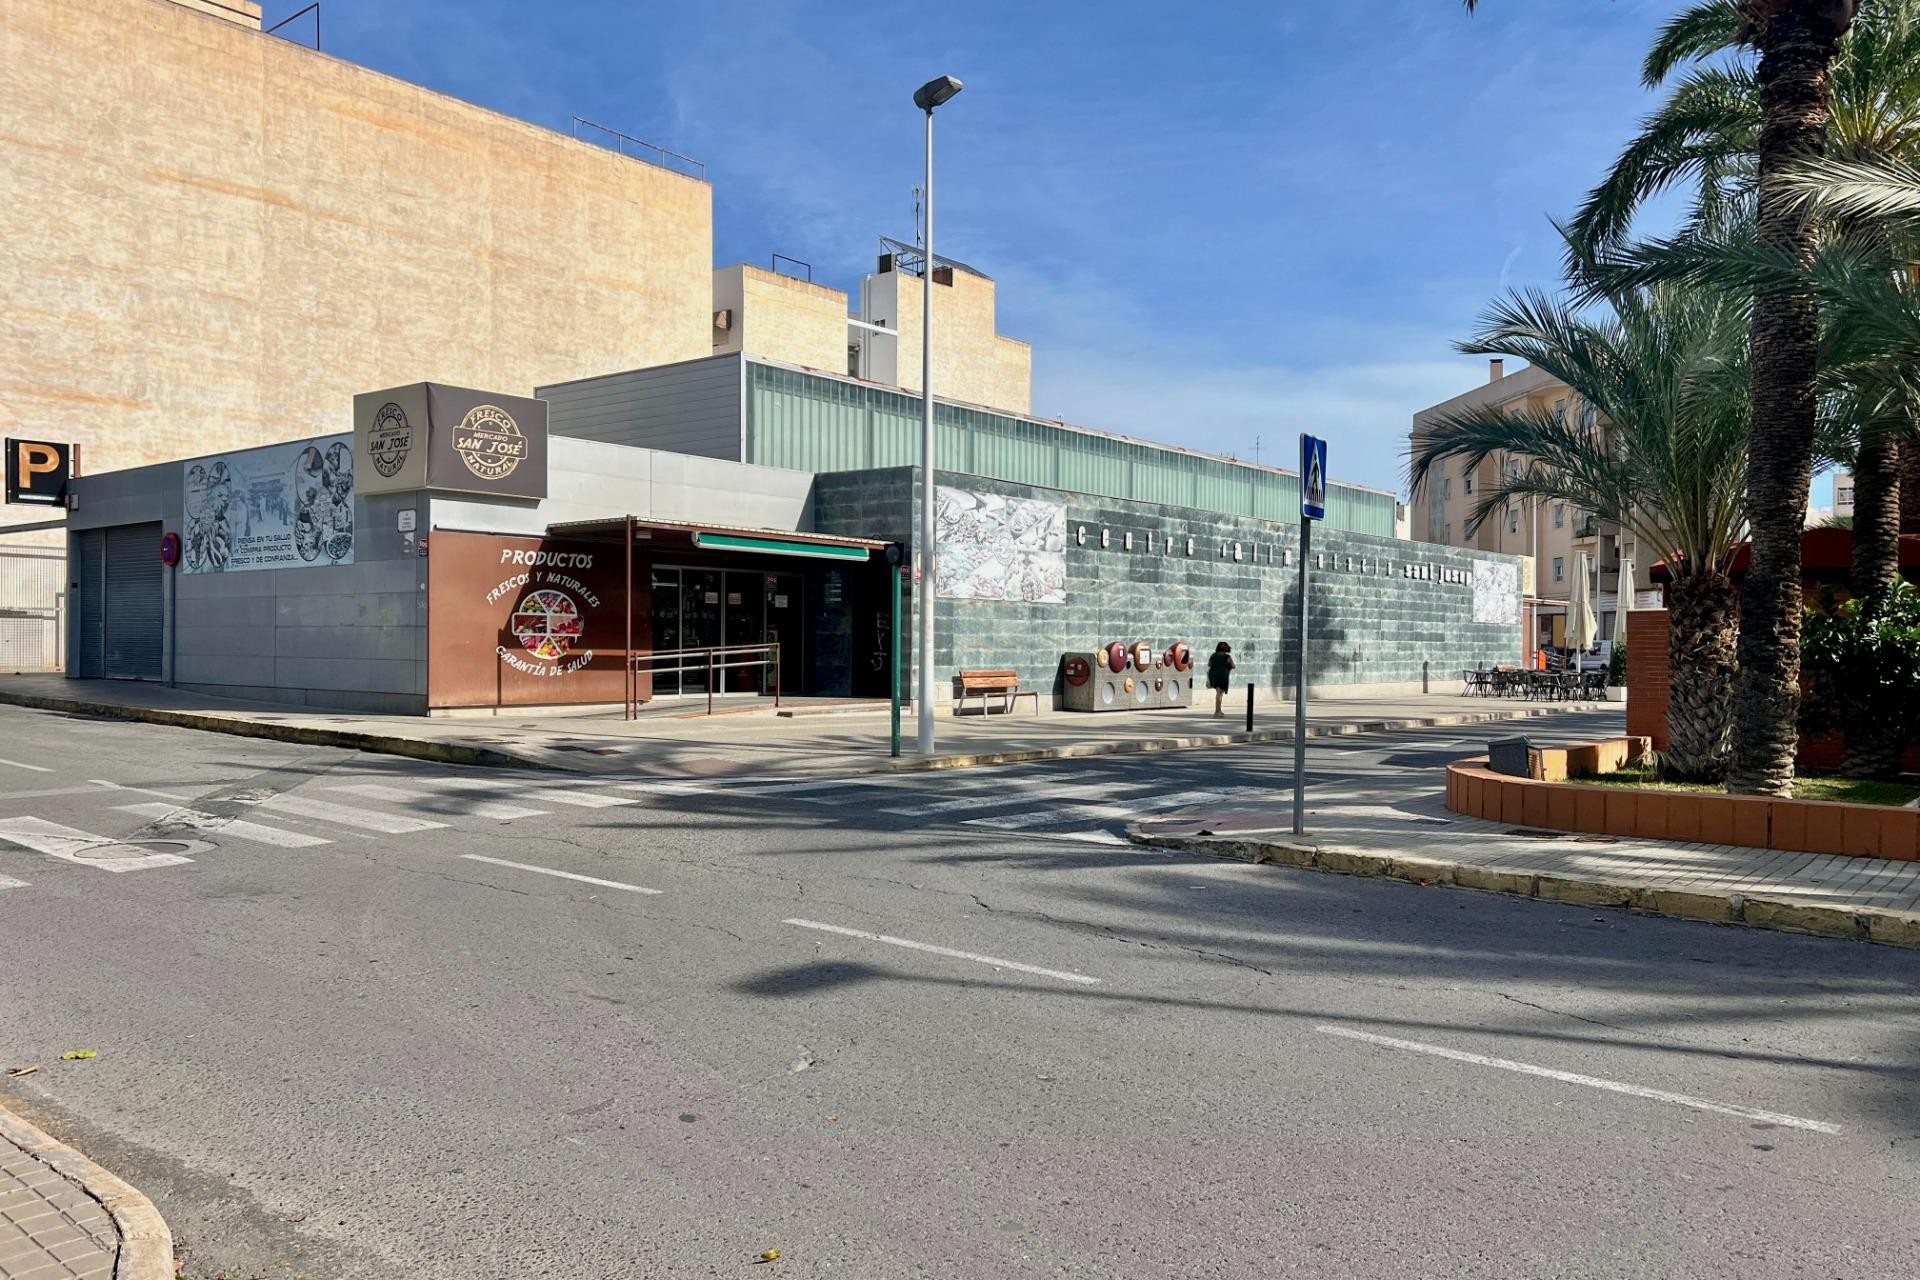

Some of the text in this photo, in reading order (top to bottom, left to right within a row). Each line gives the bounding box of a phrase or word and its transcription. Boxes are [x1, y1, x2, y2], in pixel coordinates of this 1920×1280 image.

[470, 409, 511, 429] FRESCO
[370, 431, 410, 452] SAN JOSÉ
[457, 437, 523, 455] SAN JOSÉ
[472, 432, 508, 442] MERCADO
[18, 442, 60, 489] P
[467, 455, 512, 475] NATURAL
[500, 549, 593, 569] PRODUCTOS
[486, 571, 600, 608] FRESCOS Y NATURALES
[495, 645, 594, 677] GARANTÍA DE SALUD
